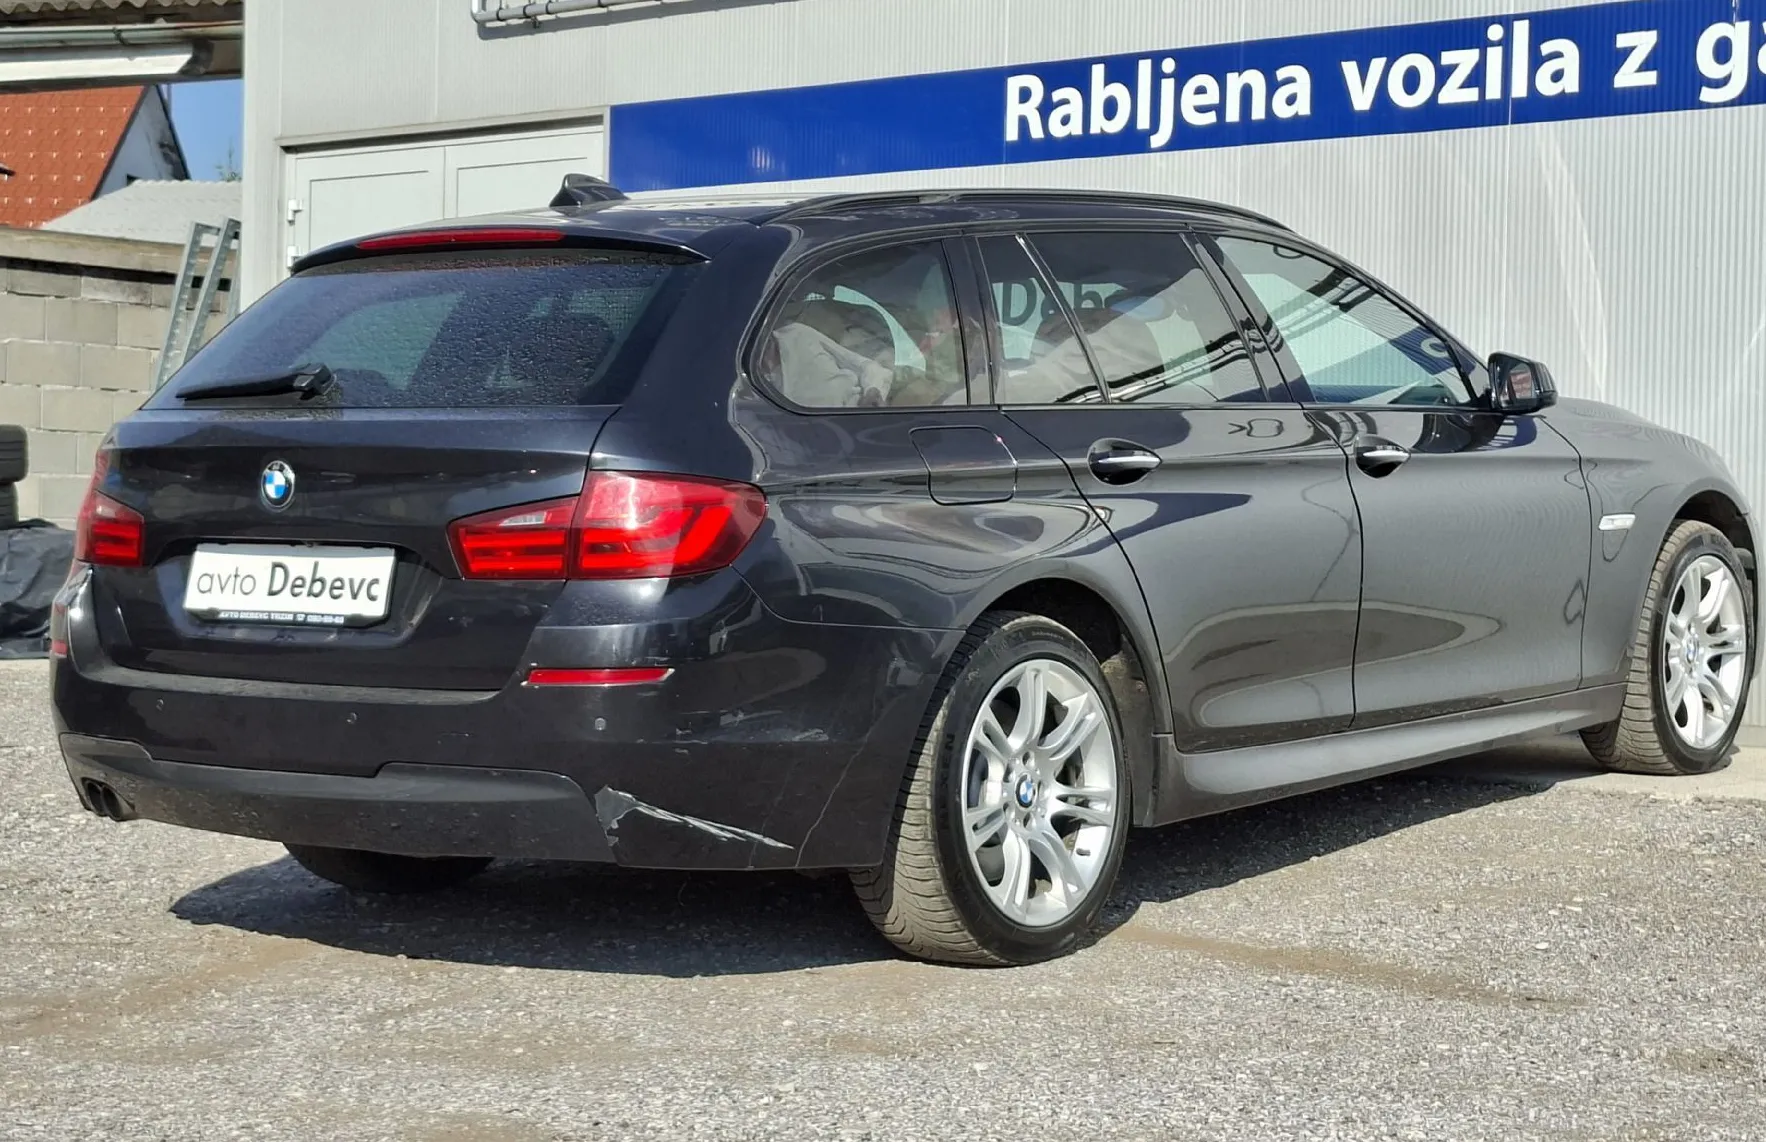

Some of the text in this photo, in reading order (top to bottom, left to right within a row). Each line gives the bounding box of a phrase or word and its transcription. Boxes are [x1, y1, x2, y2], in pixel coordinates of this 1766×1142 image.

[1005, 20, 1766, 149] Rabljena vozila z g
[197, 561, 379, 602] avto Debevc
